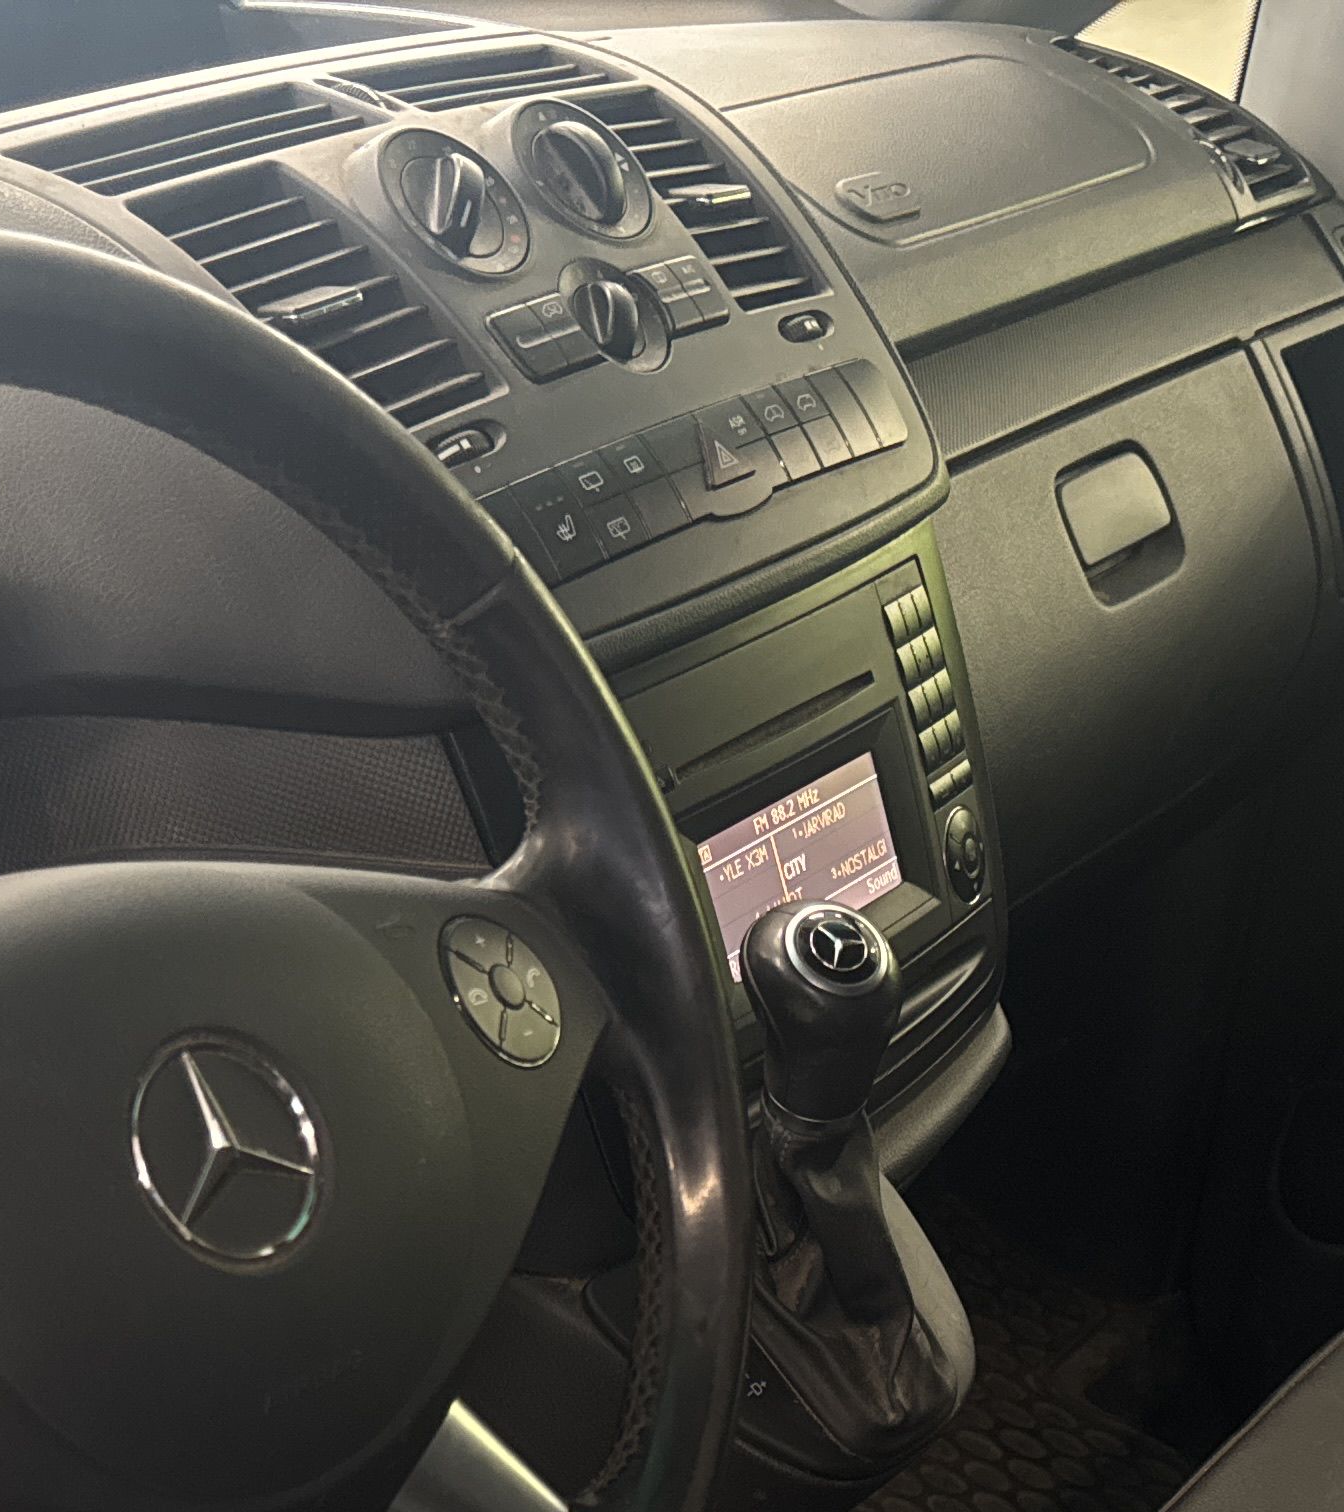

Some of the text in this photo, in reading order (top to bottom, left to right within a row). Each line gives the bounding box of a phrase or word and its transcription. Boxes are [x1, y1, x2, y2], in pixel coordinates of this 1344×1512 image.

[753, 788, 821, 836] FM 88.2 MHz
[722, 857, 745, 882] YLE
[783, 852, 807, 880] CITY
[866, 862, 899, 894] Sound
